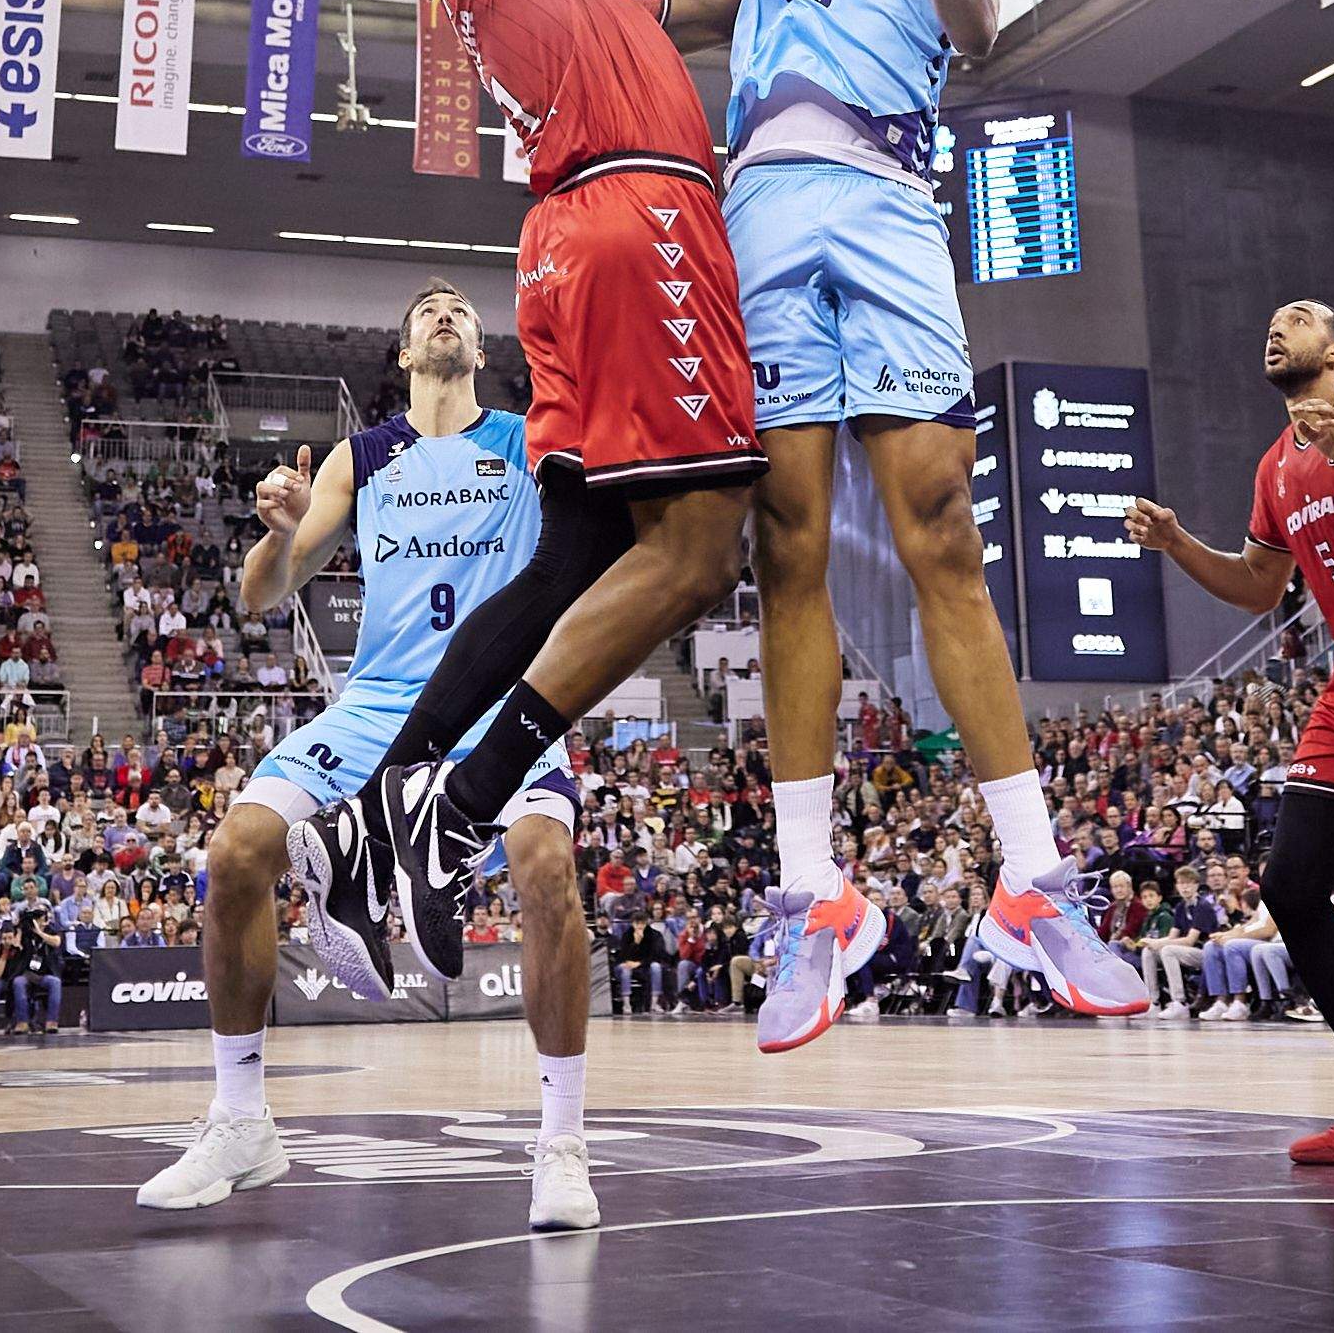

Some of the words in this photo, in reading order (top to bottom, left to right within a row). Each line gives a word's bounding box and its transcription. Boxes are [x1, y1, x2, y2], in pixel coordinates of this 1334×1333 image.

[159, 47, 178, 110] imagine.
[259, 54, 289, 131] Mica
[435, 60, 449, 143] PEREZ
[903, 368, 960, 382] andorra
[905, 382, 963, 397] telecom
[404, 535, 505, 558] Andorra
[430, 583, 455, 631] 9
